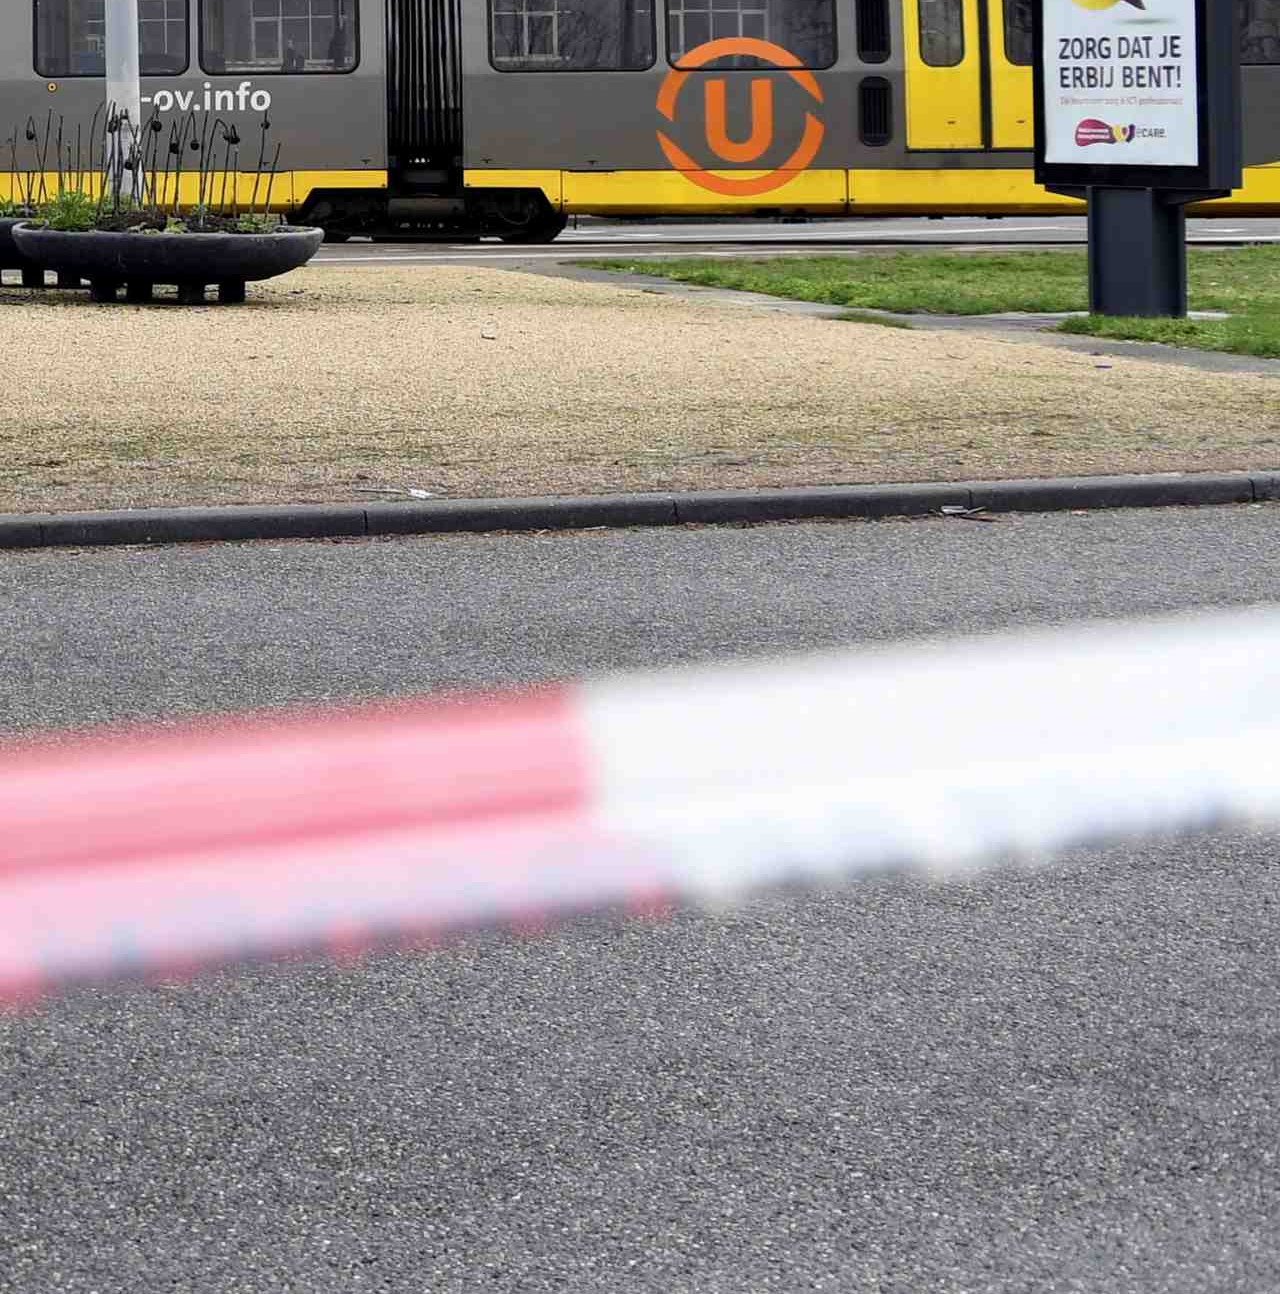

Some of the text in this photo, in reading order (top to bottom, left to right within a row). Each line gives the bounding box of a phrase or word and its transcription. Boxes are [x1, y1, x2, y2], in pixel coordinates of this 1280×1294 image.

[1058, 35, 1182, 60] ZORG DAT JE
[1059, 65, 1182, 89] ERBIJ BENT!
[140, 81, 272, 112] -ov.info
